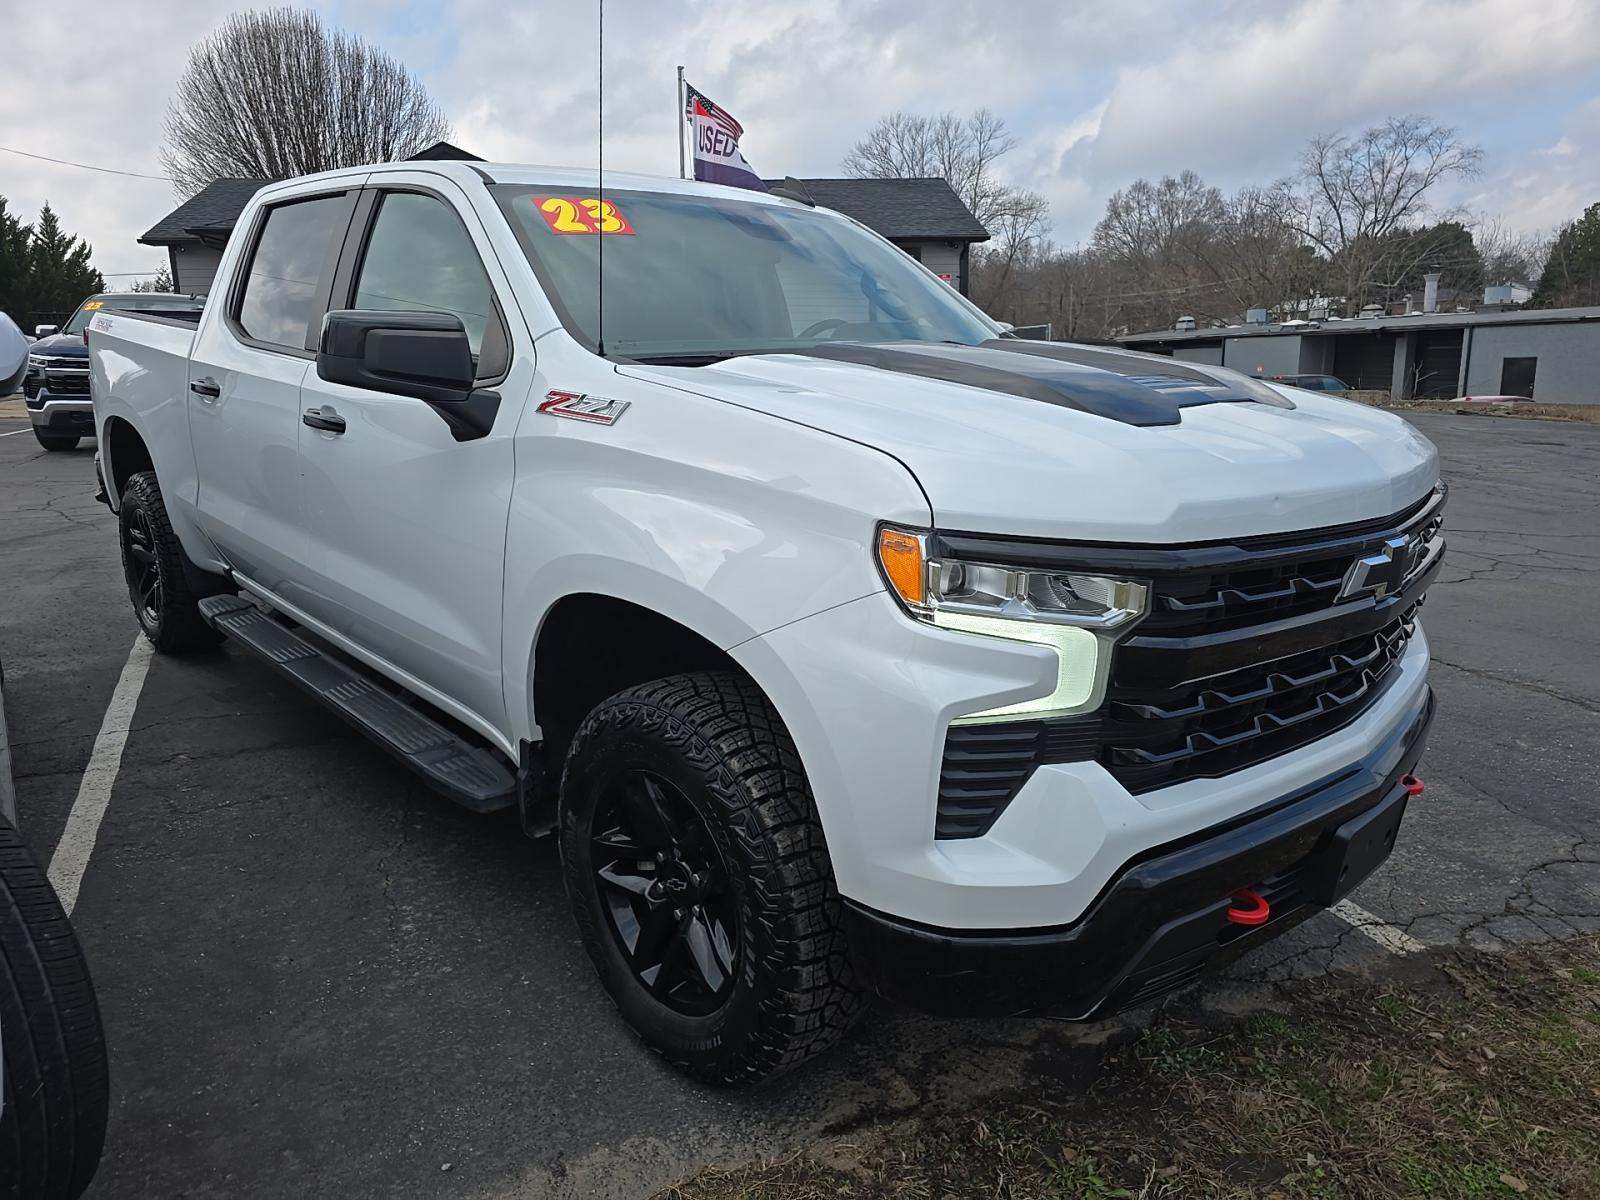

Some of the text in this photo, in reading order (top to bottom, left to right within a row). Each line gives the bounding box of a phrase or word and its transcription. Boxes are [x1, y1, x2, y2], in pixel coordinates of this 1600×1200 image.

[699, 124, 736, 157] USED
[541, 198, 626, 233] 23
[535, 390, 632, 426] Z71
